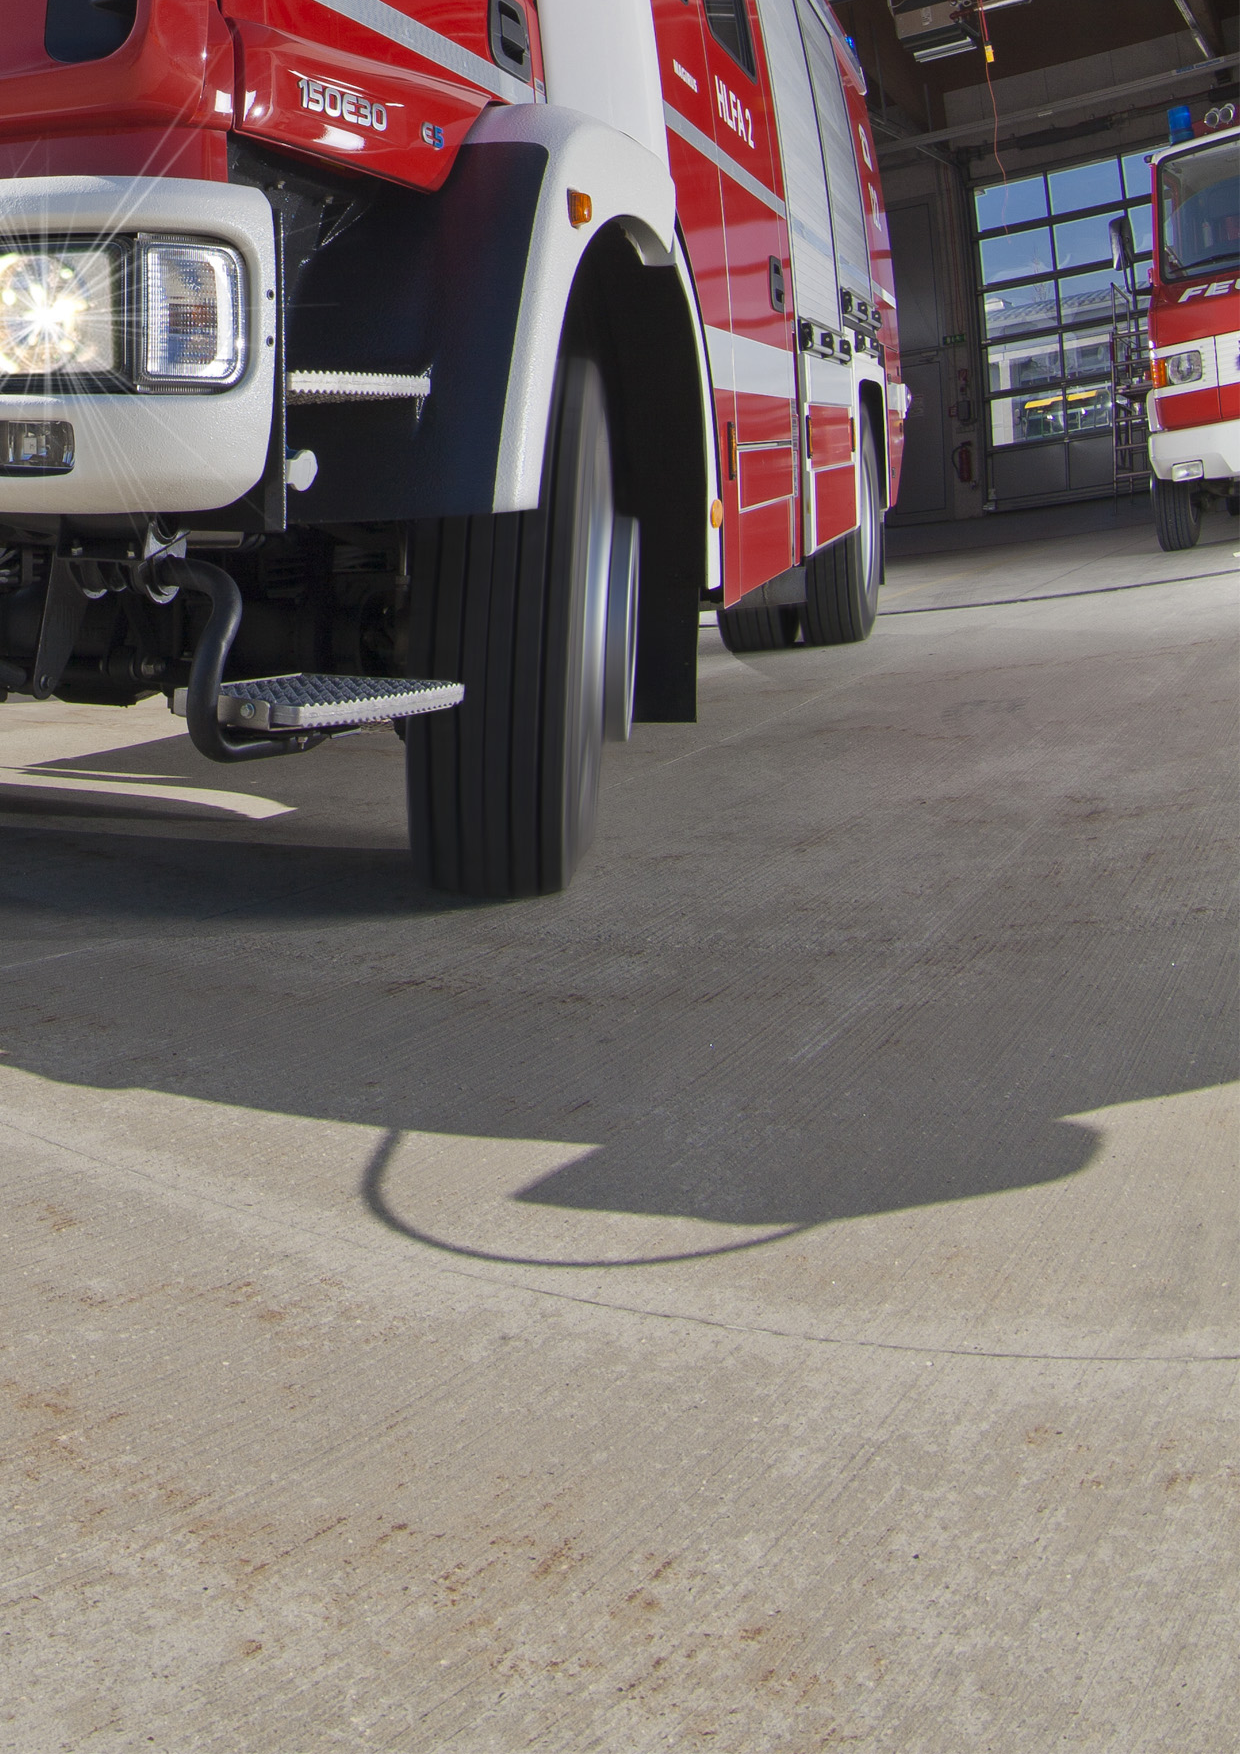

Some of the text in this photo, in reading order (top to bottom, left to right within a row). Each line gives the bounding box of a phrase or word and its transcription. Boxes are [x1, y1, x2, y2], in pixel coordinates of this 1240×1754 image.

[297, 78, 388, 132] 150E30
[714, 74, 756, 150] HLFA 2
[421, 121, 445, 150] E5
